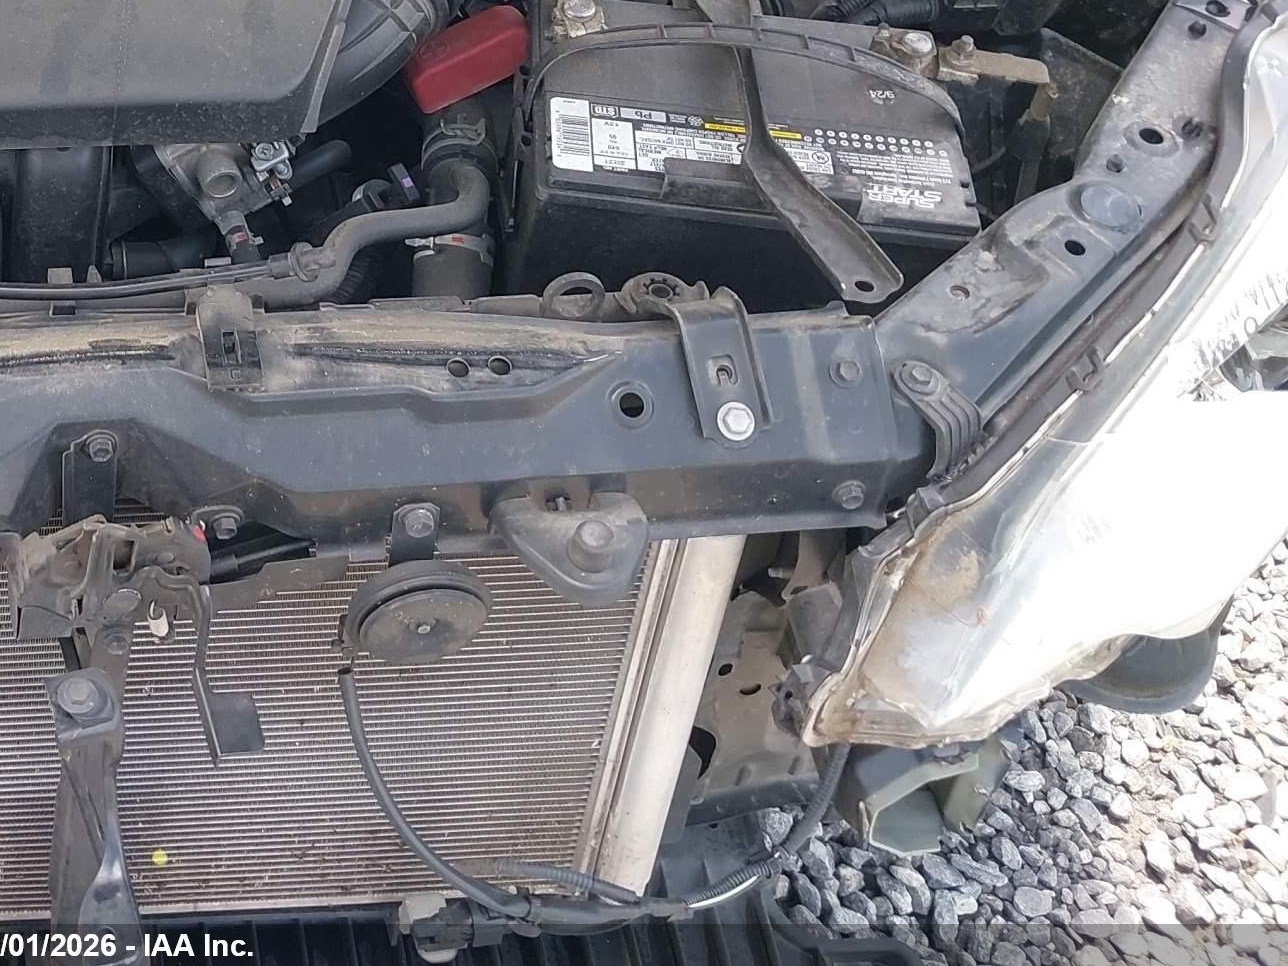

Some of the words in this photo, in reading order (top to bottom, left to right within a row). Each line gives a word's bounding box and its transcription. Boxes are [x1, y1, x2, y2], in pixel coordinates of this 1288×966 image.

[869, 89, 895, 99] 9/24
[634, 110, 652, 120] Pb
[866, 185, 943, 203] START
[867, 192, 935, 209] SUPER
